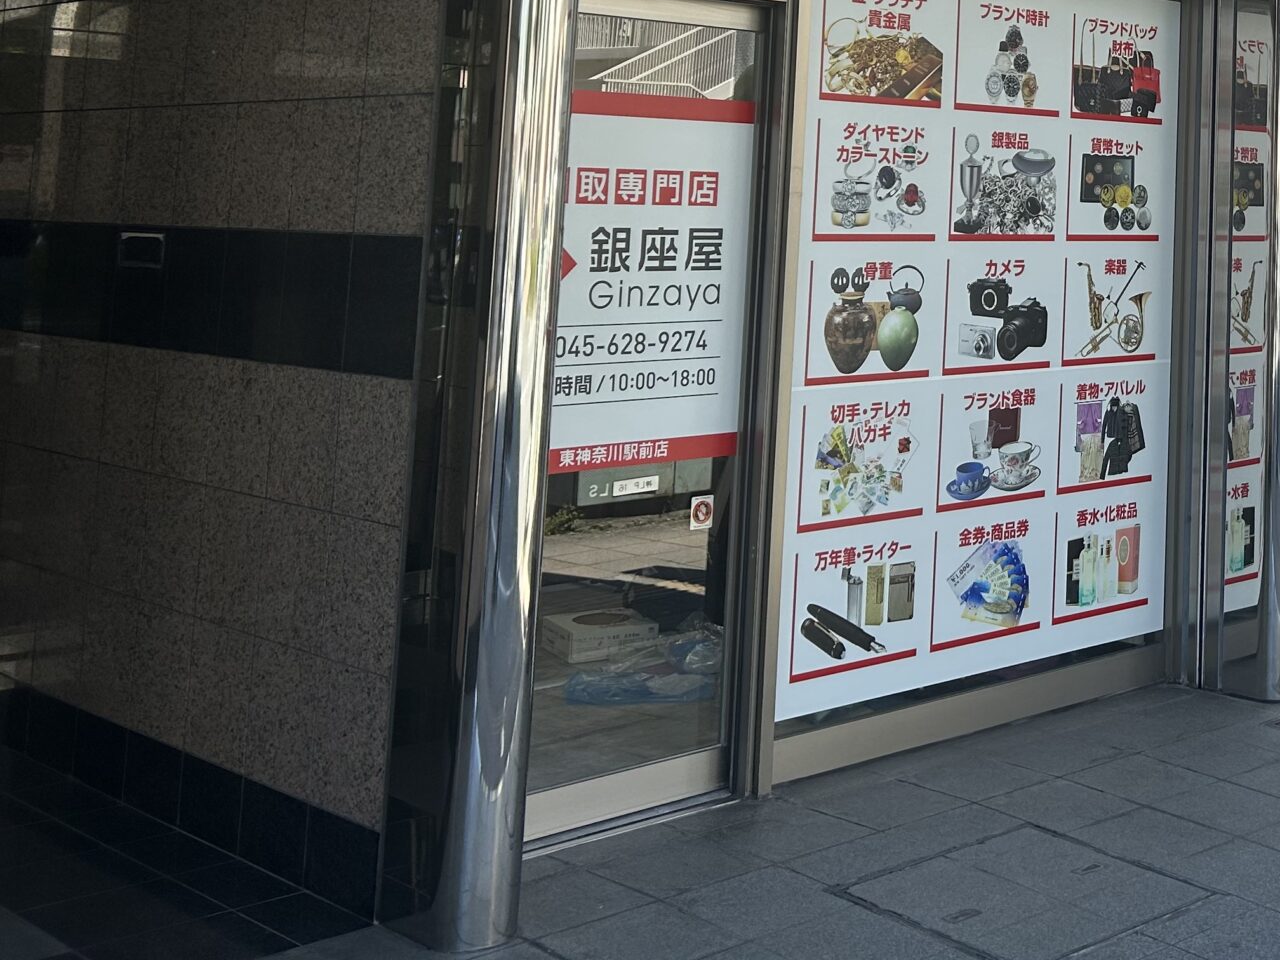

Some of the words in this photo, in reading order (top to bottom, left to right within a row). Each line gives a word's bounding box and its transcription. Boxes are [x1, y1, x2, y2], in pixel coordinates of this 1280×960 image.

[867, 9, 911, 31] 貴金属
[980, 3, 1050, 27] ブランド時計
[1088, 18, 1158, 40] ブランドバッグ
[1112, 40, 1134, 58] 財布
[843, 122, 926, 143] ダイヤモンド
[991, 131, 1029, 150] 銀製品
[836, 145, 929, 165] カラーストーン
[1090, 137, 1144, 155] 貨幣セット
[589, 227, 724, 272] 銀座屋
[864, 261, 893, 281] 骨董
[985, 259, 1026, 278] カメラ
[1104, 258, 1127, 275] 楽器
[589, 280, 721, 311] Ginzaya
[555, 330, 708, 358] 045-628-9274
[963, 388, 1036, 411] ブランド食器
[1076, 380, 1146, 400] 着物・アパレル
[830, 400, 911, 423] 切手・テレカ
[848, 423, 892, 445] ハガキ
[559, 440, 669, 467] 東神奈川駅前店
[1076, 502, 1138, 527] 香水・化粧品
[958, 519, 1030, 548] 金券・商品券
[814, 539, 912, 572] 万年筆・ライター
